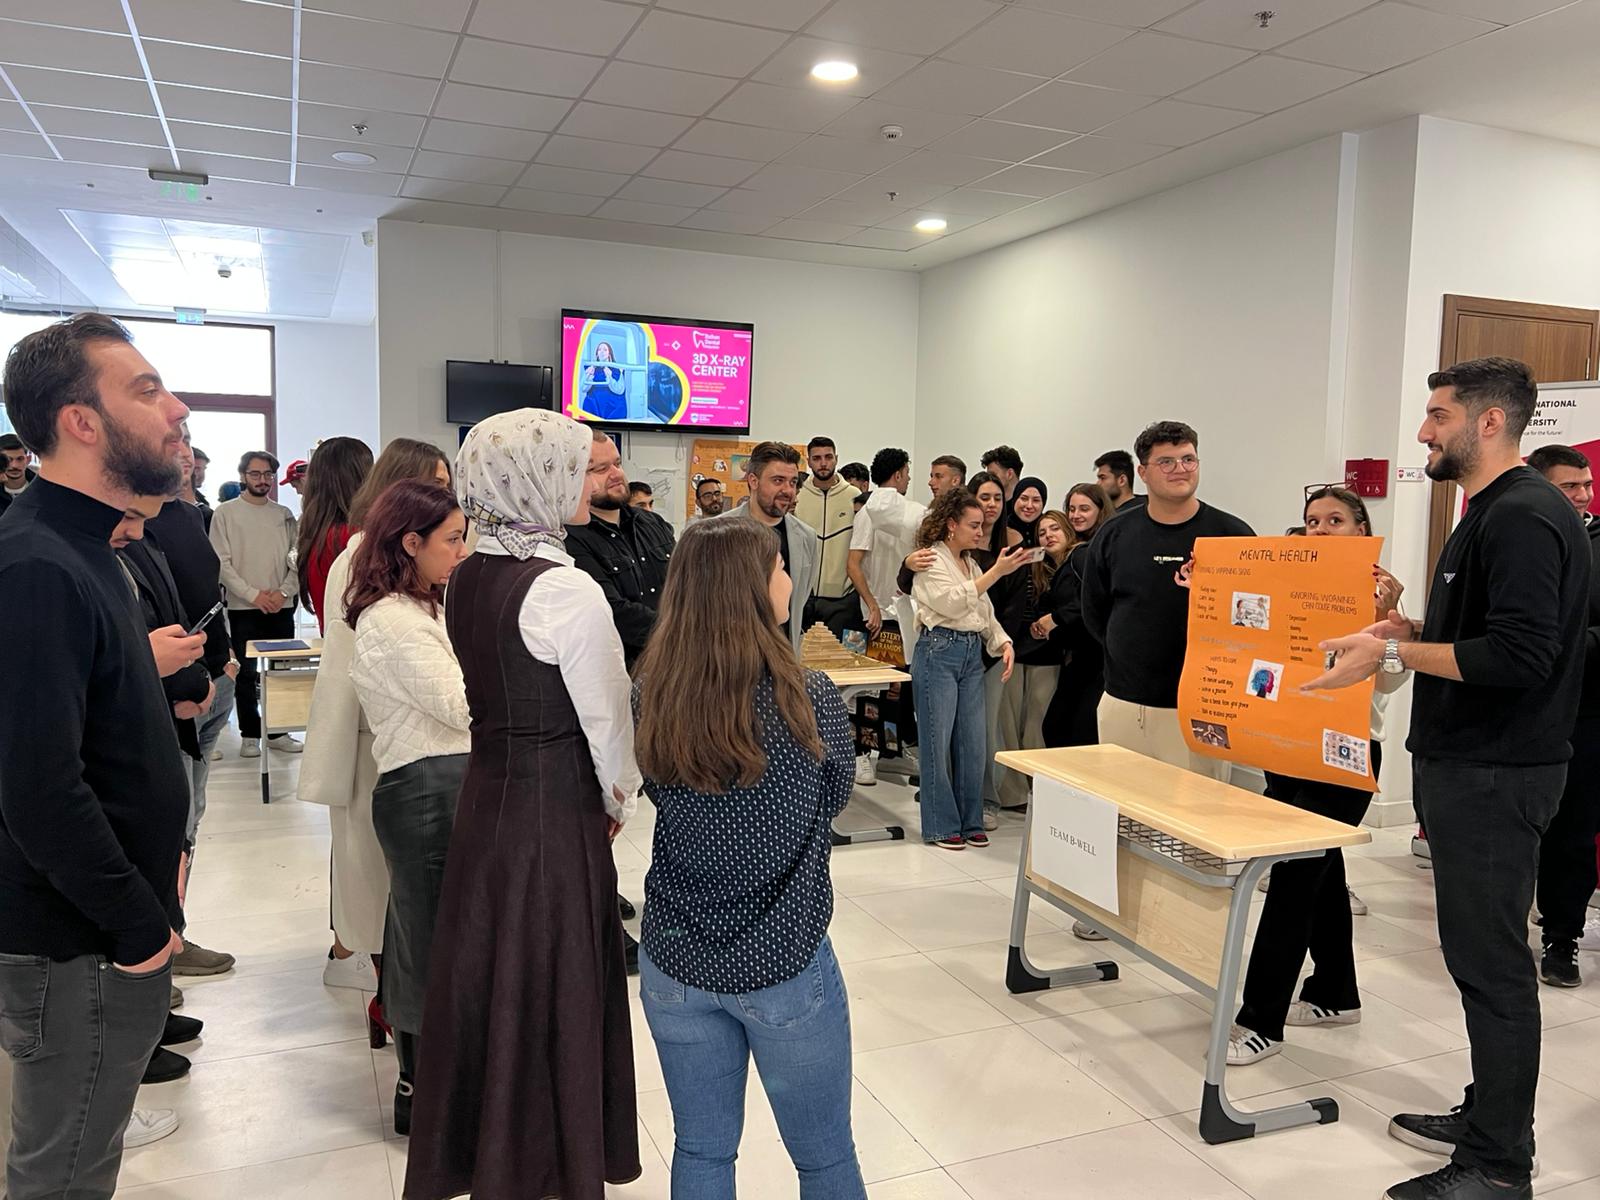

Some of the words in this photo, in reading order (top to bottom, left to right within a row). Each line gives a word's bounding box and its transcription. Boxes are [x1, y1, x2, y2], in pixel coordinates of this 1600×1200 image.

[692, 353, 708, 365] 3D
[710, 354, 746, 367] X-RAY
[691, 364, 738, 378] CENTER
[1535, 400, 1577, 408] NATIONAL
[1346, 471, 1358, 480] WC
[1239, 549, 1276, 562] MENTAL
[1280, 549, 1318, 562] HEALTH
[1049, 825, 1069, 843] TEAM
[1070, 835, 1097, 856] B-WELL
